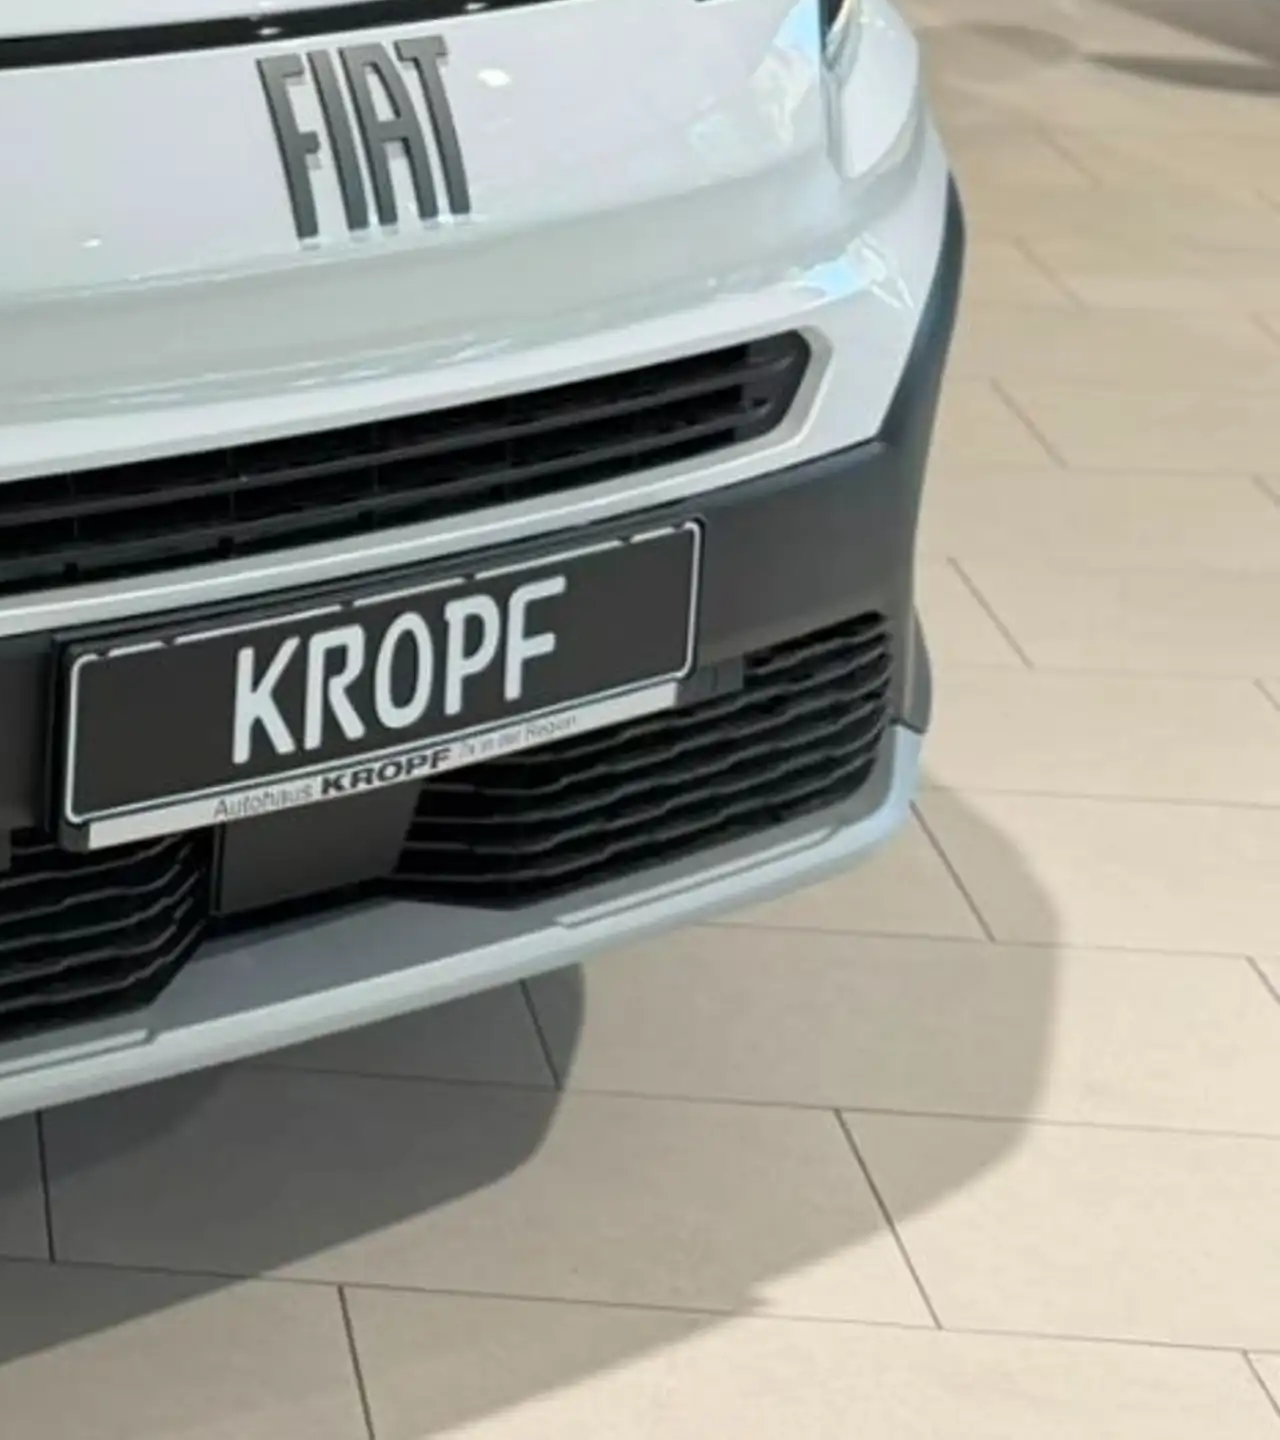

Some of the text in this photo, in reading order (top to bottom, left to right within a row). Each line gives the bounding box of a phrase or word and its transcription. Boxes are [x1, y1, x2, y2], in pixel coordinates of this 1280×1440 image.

[255, 34, 472, 241] FIAT
[232, 575, 567, 765] KROPF
[213, 782, 314, 819] Autohaus
[320, 747, 452, 796] KROPF
